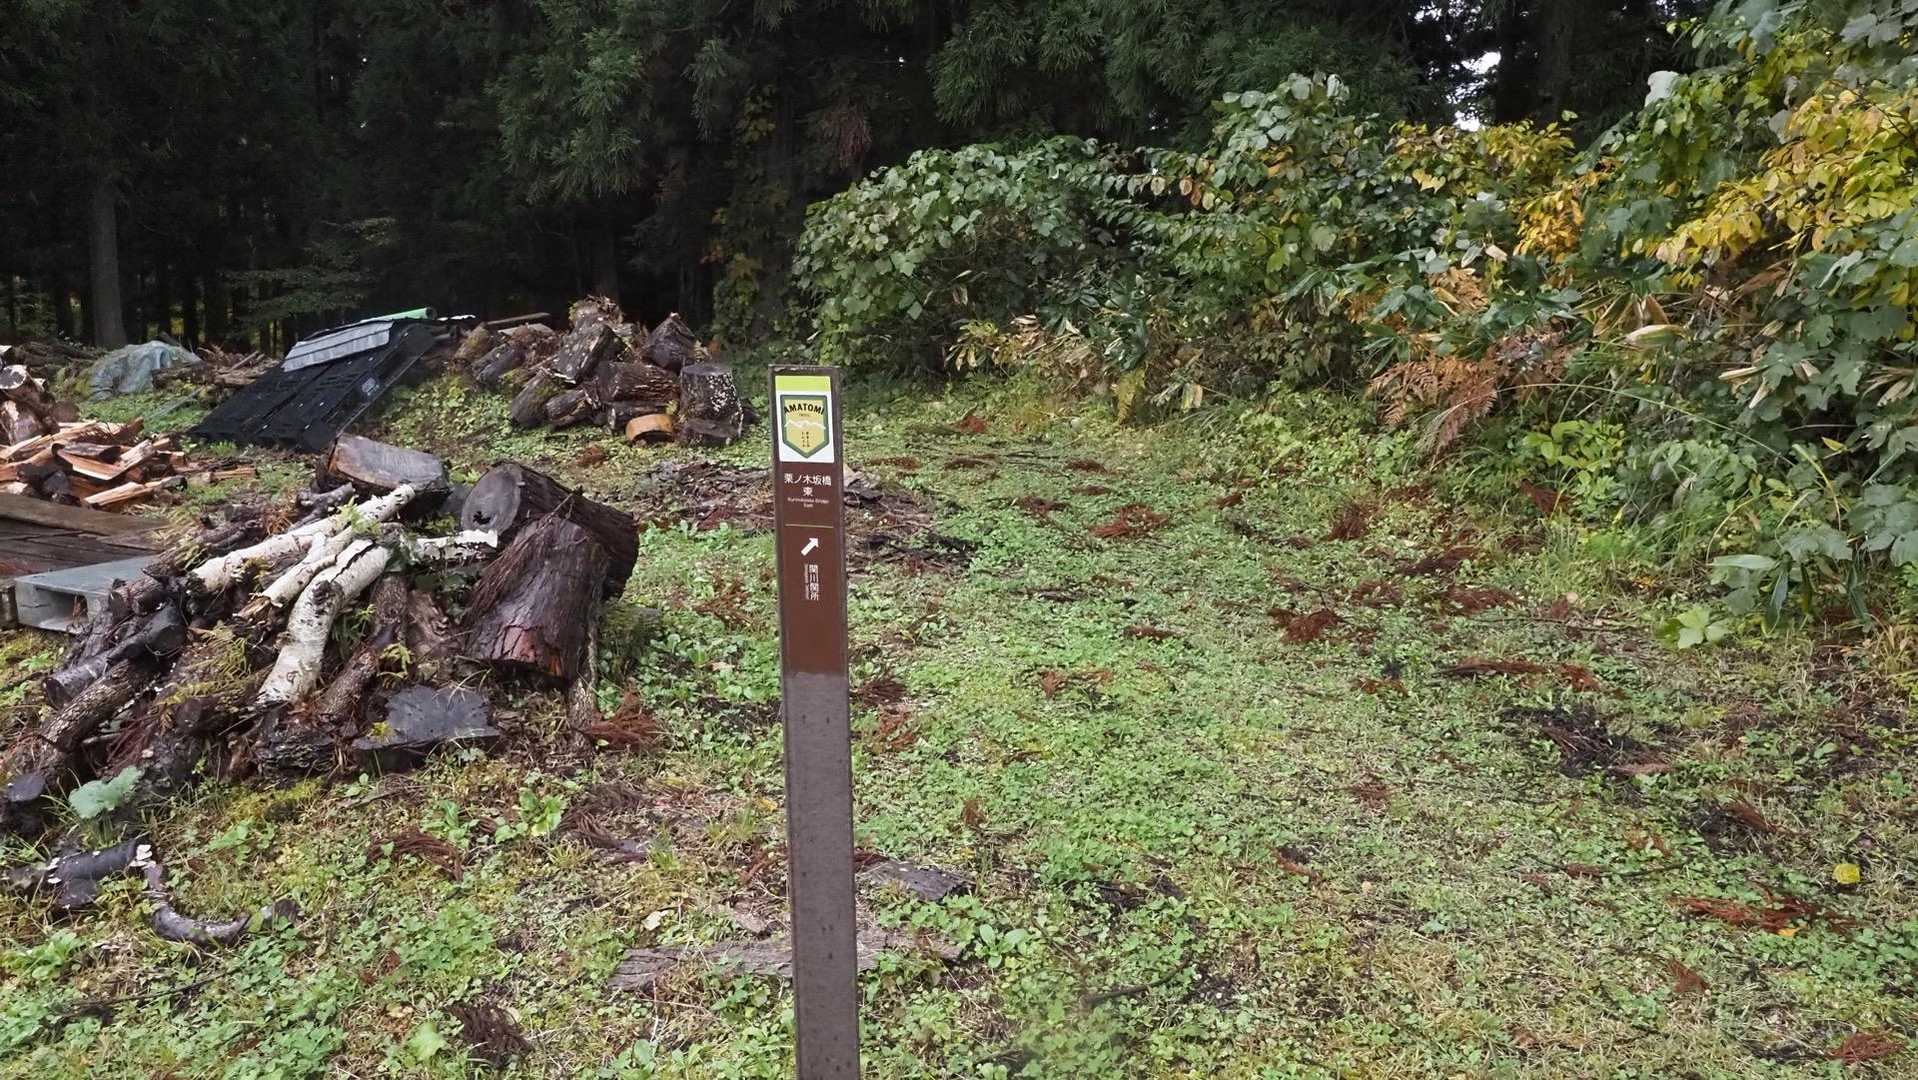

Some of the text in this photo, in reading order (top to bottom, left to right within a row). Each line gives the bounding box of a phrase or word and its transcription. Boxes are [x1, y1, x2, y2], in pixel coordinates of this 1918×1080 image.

[784, 403, 825, 415] AMATOMI
[808, 564, 819, 601] 関川関所
